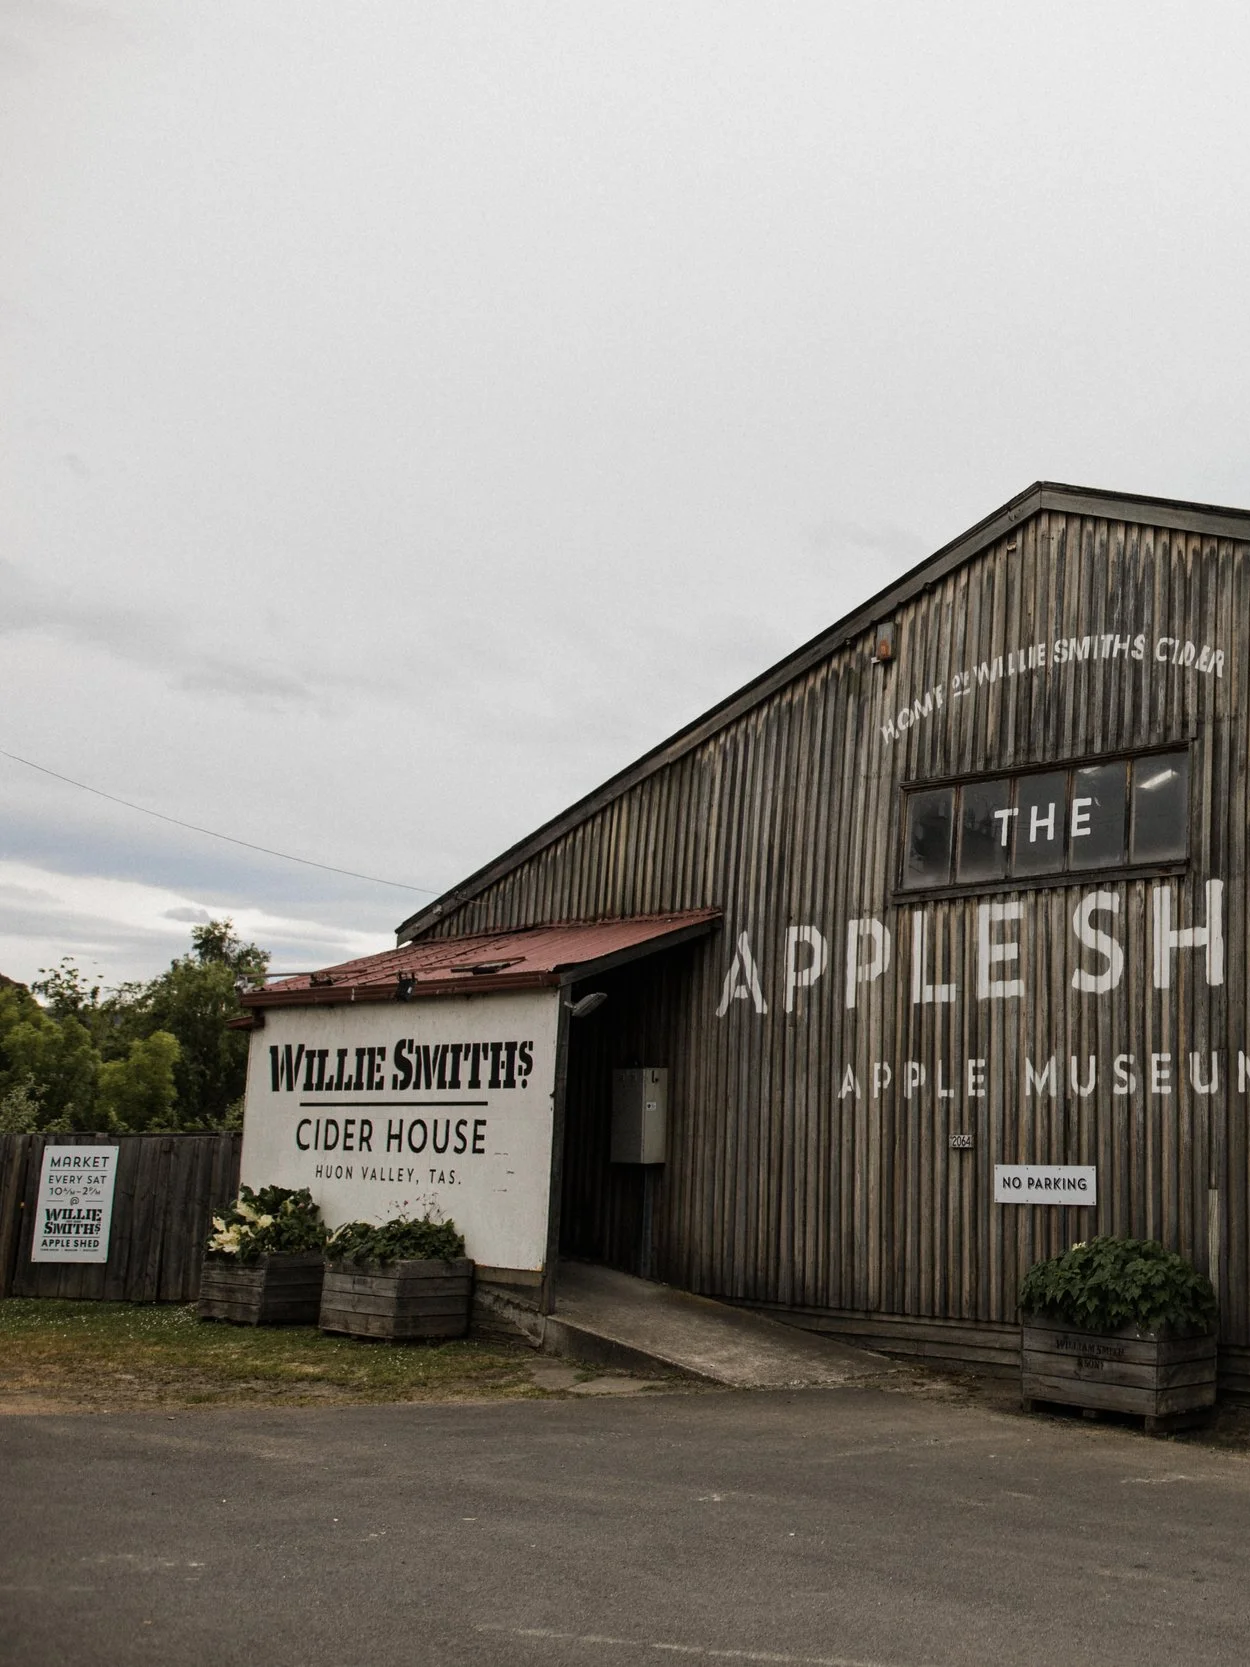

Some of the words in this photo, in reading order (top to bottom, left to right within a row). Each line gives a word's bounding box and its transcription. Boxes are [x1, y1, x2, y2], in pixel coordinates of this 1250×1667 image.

[880, 684, 943, 743] HOME
[973, 643, 1046, 687] WILLIE
[1053, 634, 1146, 663] SMITHS
[1155, 637, 1225, 678] CIDER
[994, 798, 1092, 846] THE
[716, 902, 1024, 1017] APPLE
[270, 1044, 386, 1091] WILLIE
[838, 1059, 986, 1099] APPLE
[296, 1119, 373, 1152] CIDER
[386, 1119, 488, 1154] HOUSE
[952, 1136, 971, 1147] 2064
[50, 1156, 110, 1168] MARKET
[48, 1175, 83, 1184] EVERY
[87, 1176, 107, 1184] SAT
[315, 1165, 353, 1179] HUON
[361, 1166, 419, 1184] VALLEY,
[429, 1169, 462, 1184] TAS.
[1002, 1177, 1022, 1189] NO
[1027, 1177, 1088, 1191] PARKING
[70, 1197, 80, 1206] @
[45, 1208, 103, 1222] WILLIE
[41, 1239, 71, 1248] APPLE
[73, 1240, 100, 1248] SHED
[1056, 1339, 1095, 1353] WILLIAM
[1096, 1345, 1125, 1357] SMITH
